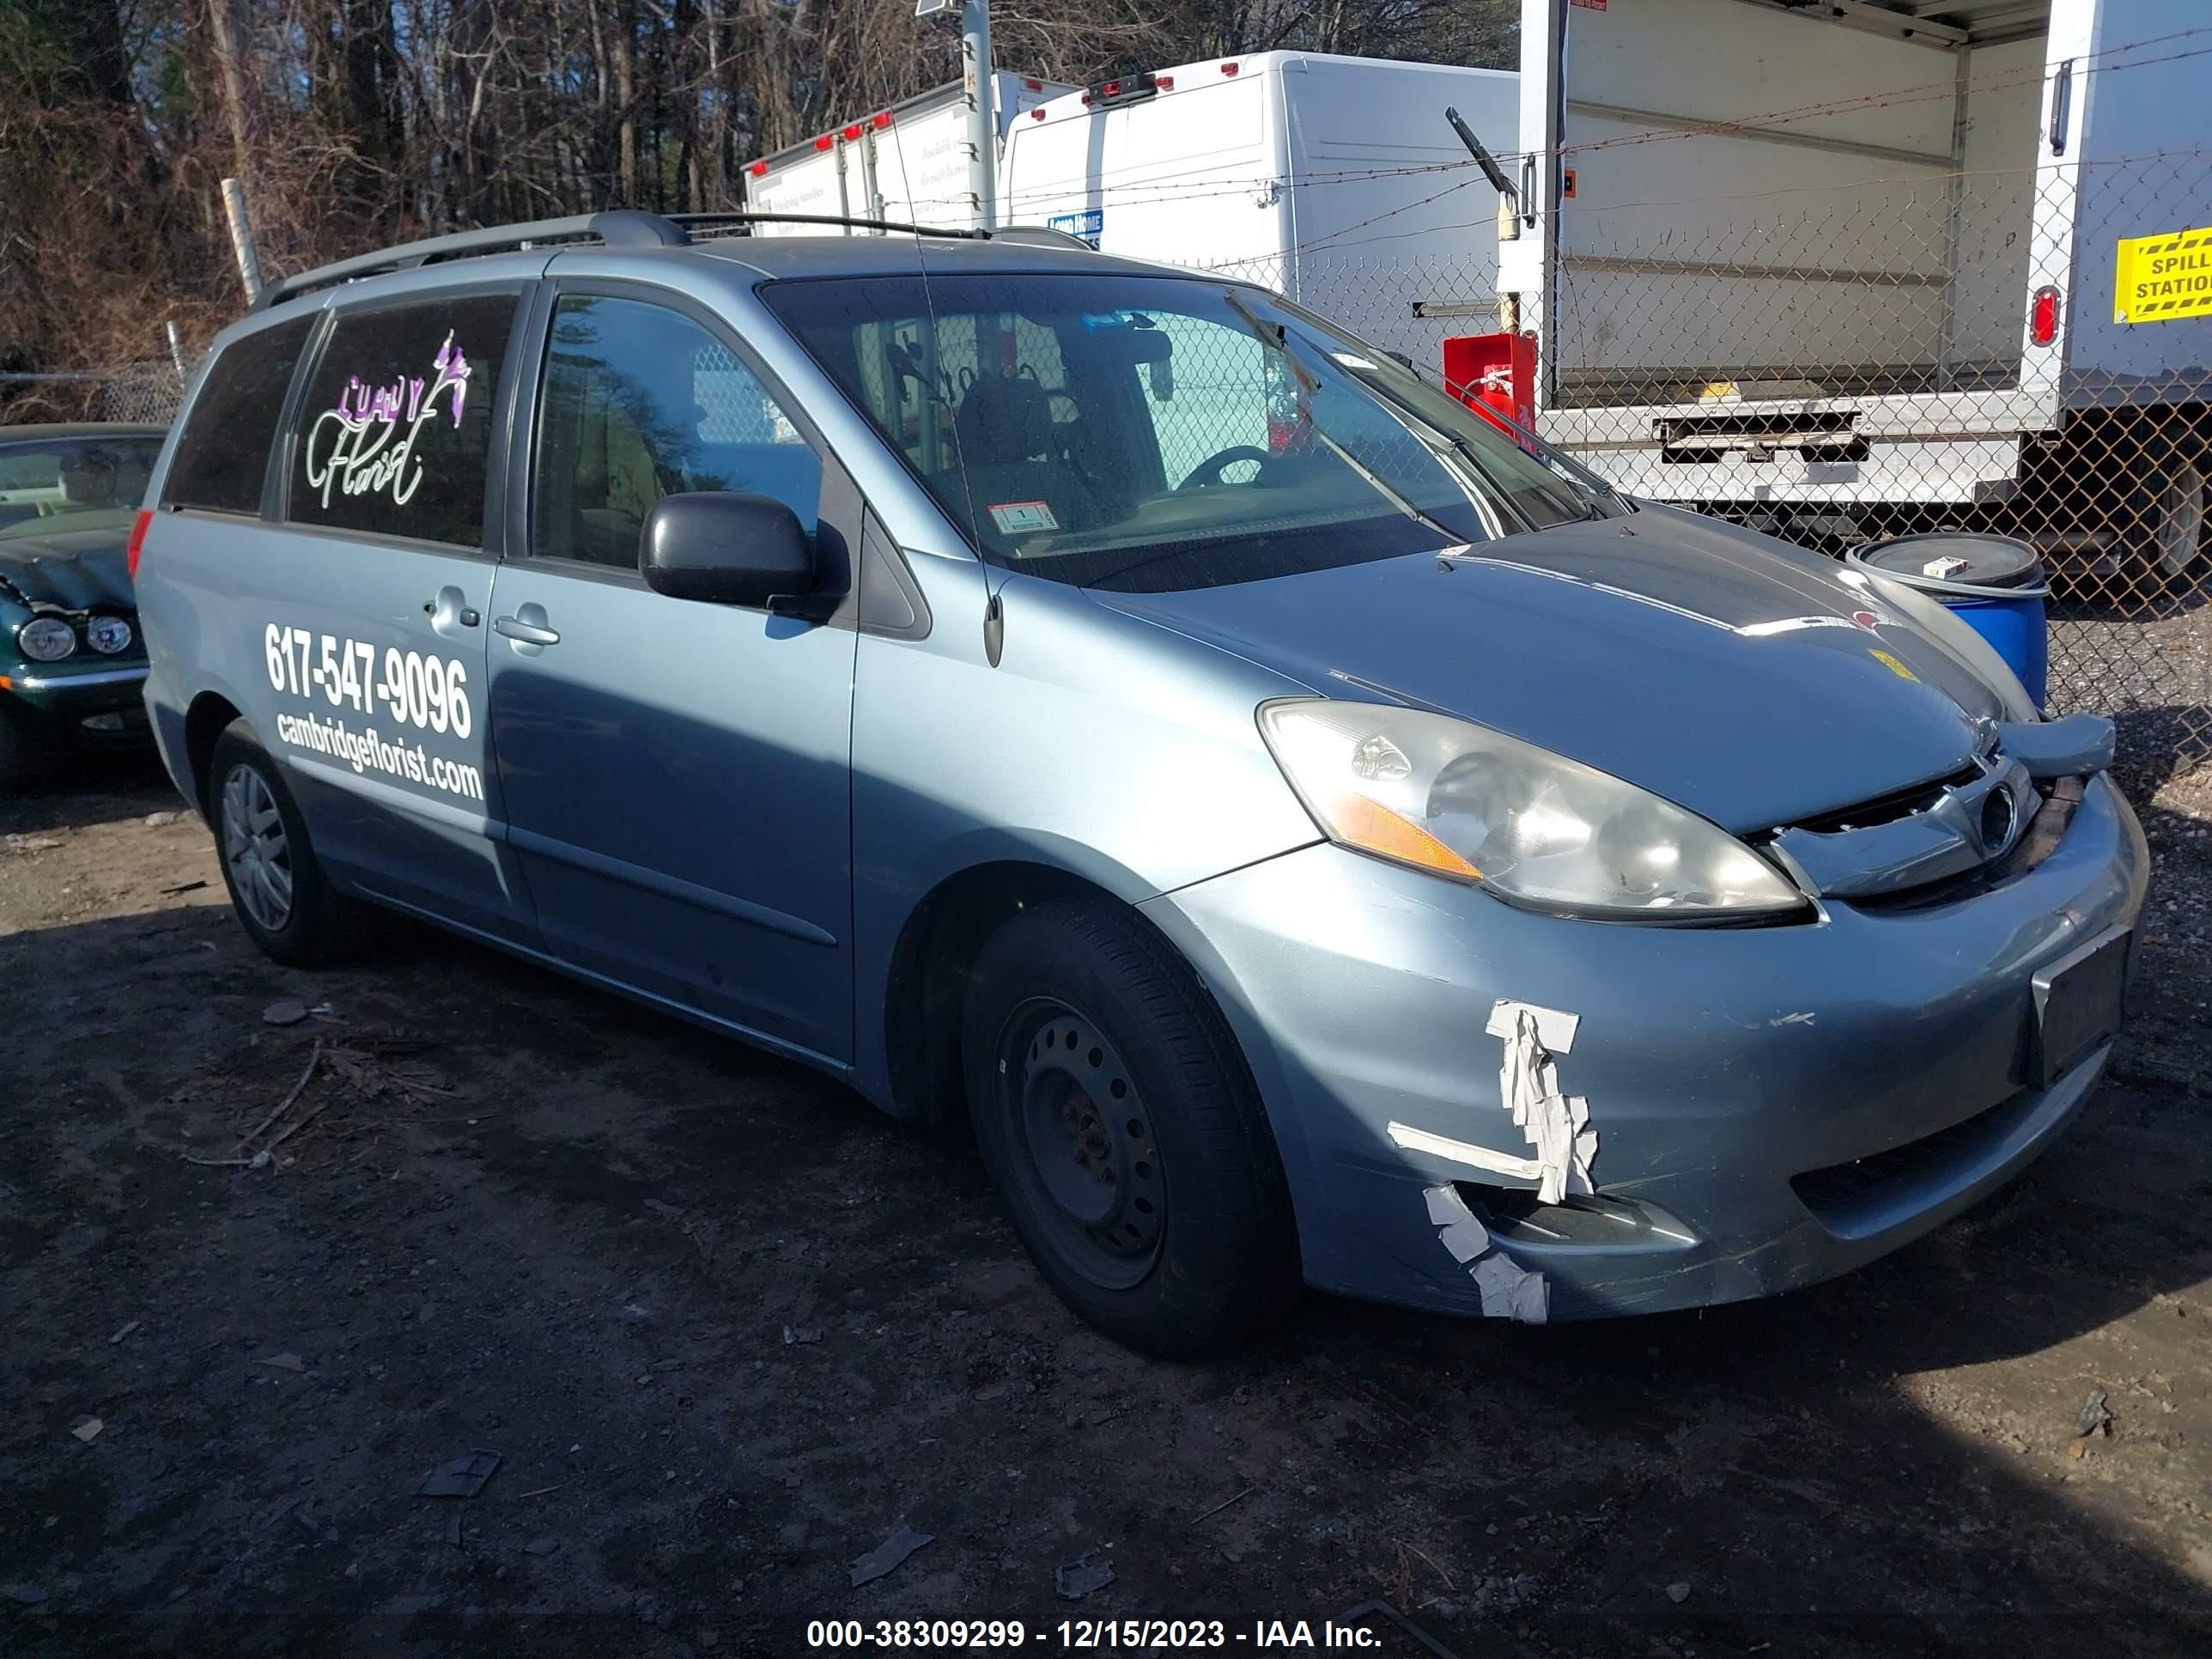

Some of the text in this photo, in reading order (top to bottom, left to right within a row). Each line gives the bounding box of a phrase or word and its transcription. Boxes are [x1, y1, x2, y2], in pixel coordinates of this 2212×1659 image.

[2136, 275, 2212, 299] STATIO
[2152, 252, 2211, 275] SPILL
[265, 623, 471, 739] 617-547-9096
[276, 712, 483, 800] cambridgeflorist.com
